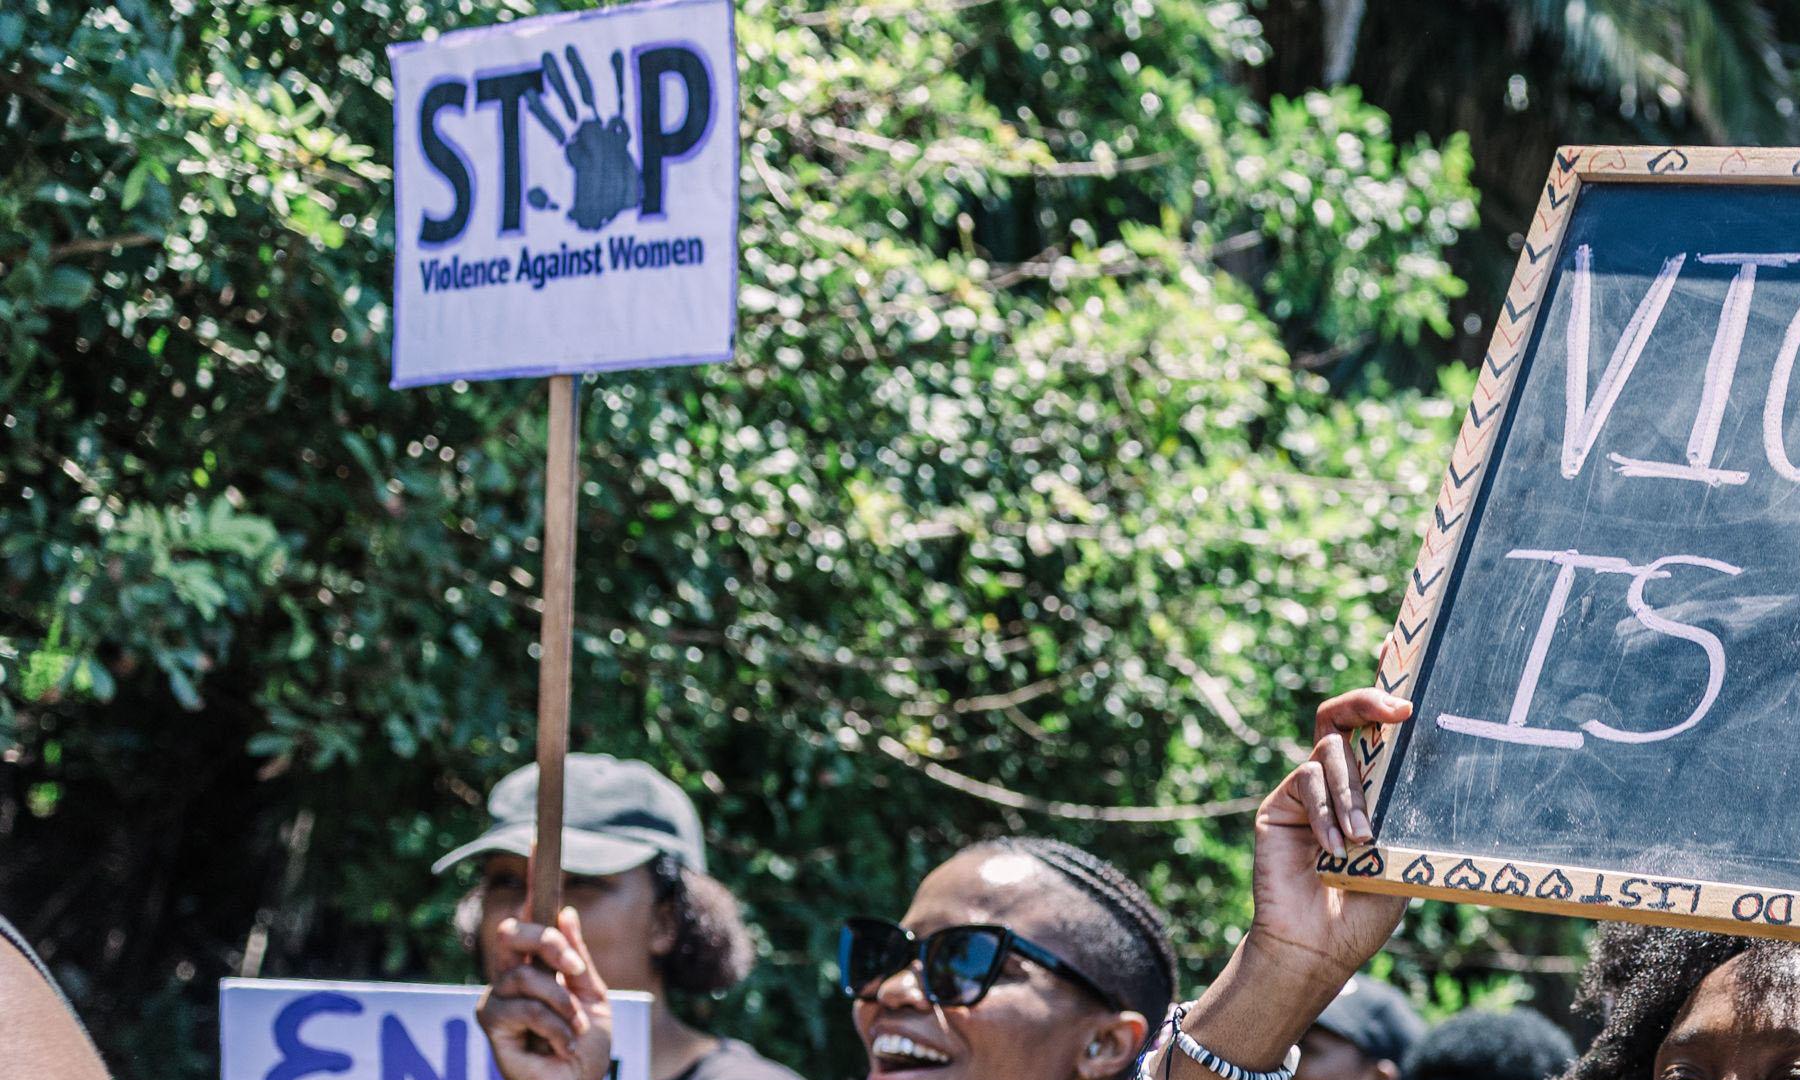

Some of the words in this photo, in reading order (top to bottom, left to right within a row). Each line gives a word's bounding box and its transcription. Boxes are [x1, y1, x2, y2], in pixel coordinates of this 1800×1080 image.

[420, 254, 510, 293] Violence
[516, 242, 602, 290] Against
[609, 235, 704, 270] Women
[1436, 547, 1743, 747] IS
[1580, 873, 1703, 914] LIST
[1732, 892, 1795, 926] DO
